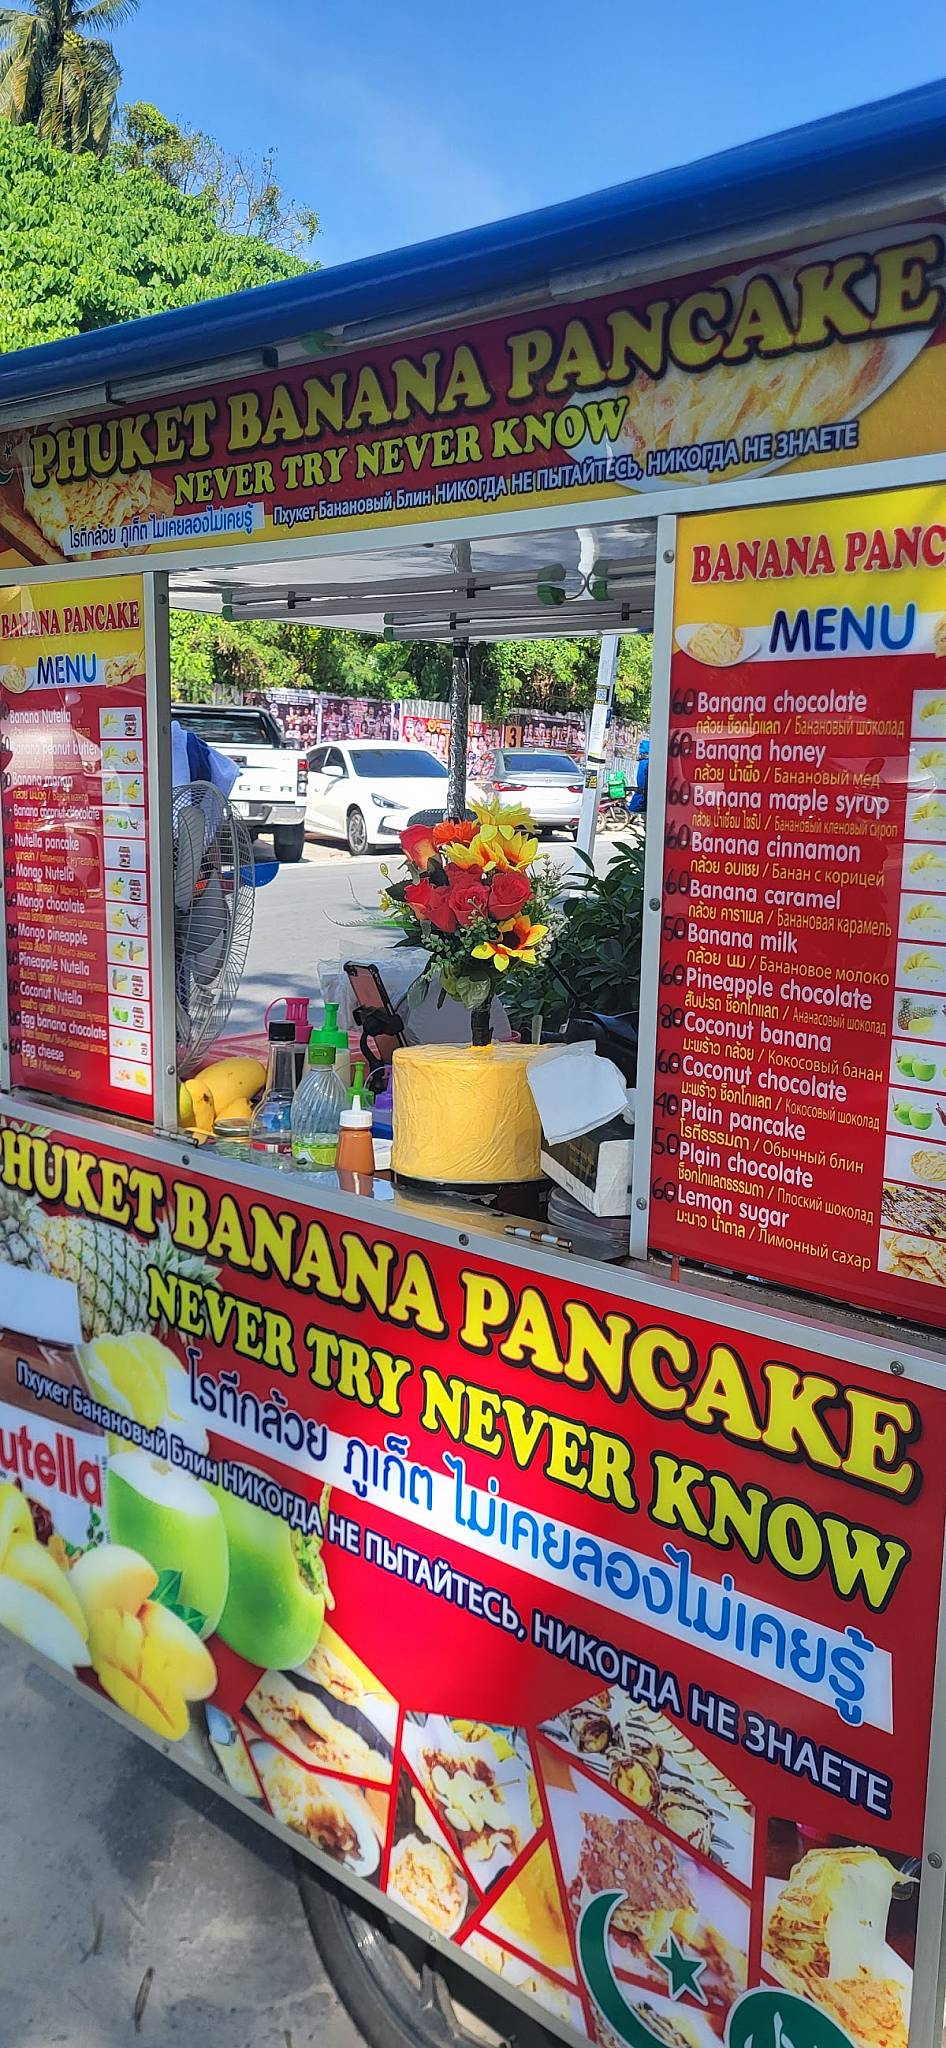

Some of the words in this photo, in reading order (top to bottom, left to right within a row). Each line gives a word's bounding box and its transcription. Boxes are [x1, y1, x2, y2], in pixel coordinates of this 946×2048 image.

[29, 398, 217, 485] PHUKET
[228, 345, 492, 450] BANANA
[506, 240, 941, 400] PANCAKE
[174, 460, 275, 505] NEVER
[281, 447, 350, 488] TRY
[355, 427, 482, 478] NEVER
[492, 398, 630, 458] KNOW
[274, 506, 315, 527] Пхукет
[319, 494, 394, 519] Банановый
[396, 488, 431, 507] Блин
[435, 476, 508, 502] НИКОГДА
[511, 472, 533, 493] НЕ
[536, 460, 643, 491] ПЫТАЙТЕСЬ,
[647, 443, 739, 475] НИКОГДА
[744, 436, 773, 462] НЕ
[776, 422, 859, 457] ЗНАЕТЕ
[70, 524, 116, 549] โรตีกล้วย
[120, 516, 148, 549] ภูเก็ต
[151, 503, 254, 539] ไม่เคยลองไม่เคยรู้
[691, 534, 835, 584] BANANA
[844, 524, 946, 572] PANC
[1, 609, 61, 638] BANANA
[63, 601, 140, 633] PANCAKE
[768, 602, 916, 654] MENU
[37, 653, 97, 684] MENU
[697, 691, 766, 713] Banana
[773, 688, 867, 713] chocolate
[9, 710, 39, 724] Banana
[696, 715, 723, 734] กล้วย
[795, 715, 854, 736] Банановый
[856, 720, 904, 740] шоколад
[695, 739, 762, 760] Banana
[769, 738, 826, 768] honey
[694, 763, 724, 781] กล้วย
[774, 768, 849, 785] Банановый
[693, 785, 761, 809] Banana
[769, 788, 829, 817] maple
[835, 795, 890, 820] syrup
[14, 833, 42, 848] Nutella
[45, 836, 80, 852] pancake
[691, 832, 759, 856] Banana
[766, 834, 860, 863] cinnamon
[45, 865, 74, 882] Nutella
[690, 854, 720, 875] กล้วย
[724, 862, 760, 877] อบเชย
[772, 863, 811, 881] Банан
[814, 871, 821, 882] с
[825, 870, 885, 888] корицей
[46, 896, 86, 914] chocolate
[690, 879, 757, 903] Banana
[764, 889, 841, 910] caramel
[688, 900, 716, 919] กล้วย
[721, 908, 764, 924] คาราเมล
[777, 908, 834, 931] Банановая
[837, 920, 892, 938] карамель
[47, 926, 88, 947] pineapple
[688, 922, 753, 948] Banana
[760, 931, 798, 954] milk
[18, 952, 59, 971] Pineapple
[60, 958, 90, 976] Nutella
[687, 946, 721, 965] กล้วย
[727, 954, 746, 968] นม
[760, 956, 832, 979] Банановое
[835, 968, 890, 986] молоко
[20, 981, 51, 999] Coconut
[53, 987, 83, 1005] Nutella
[686, 966, 774, 998] Pineapple
[780, 978, 872, 1010] chocolate
[21, 1011, 35, 1029] Egg
[37, 1013, 67, 1032] banana
[68, 1021, 107, 1040] chocolate
[684, 1011, 754, 1040] Coconut
[760, 1020, 832, 1053] banana
[793, 1007, 845, 1029] Ананасовый
[847, 1020, 887, 1037] шоколад
[21, 1040, 36, 1058] Egg
[37, 1043, 65, 1061] cheese
[683, 1036, 721, 1056] มะพร้าว
[725, 1040, 754, 1061] กล้วย
[682, 1055, 752, 1085] Coconut
[758, 1067, 847, 1102] chocolate
[768, 1049, 839, 1075] Кокосовый
[843, 1061, 883, 1082] банан
[681, 1080, 717, 1099] มะพร้าว
[720, 1082, 772, 1110] ช็อกโกแลต
[681, 1098, 723, 1125] Plain
[729, 1111, 806, 1141] pancake
[785, 1098, 836, 1121] Кокосовый
[837, 1111, 880, 1132] шоколад
[680, 1117, 750, 1151] โรตีธรรมดา
[680, 1141, 721, 1168] Plain
[727, 1151, 813, 1188] chocolate
[763, 1139, 826, 1166] Обычный
[829, 1153, 864, 1174] блин
[676, 1209, 708, 1228] มะนาว
[678, 1184, 732, 1215] Lemon
[739, 1202, 790, 1228] sugar
[777, 1187, 823, 1212] Плоский
[825, 1202, 874, 1226] шоколад
[758, 1228, 829, 1259] Лимонный
[832, 1249, 872, 1273] сахар
[0, 1129, 163, 1234] HUKET
[173, 1183, 446, 1332] BANANA
[458, 1270, 915, 1496] PANCAKE
[147, 1268, 298, 1374] NEVER
[306, 1328, 412, 1416] TRY
[422, 1370, 638, 1511] NEVER
[652, 1455, 907, 1609] KNOW
[187, 1347, 328, 1462] โรตีกล้วย
[344, 1434, 434, 1511] ภูเก็ต
[442, 1452, 876, 1726] ไม่เคยลองไม่เคยรู้
[17, 1361, 69, 1406] Пхукет
[73, 1389, 167, 1456] Банановый
[170, 1433, 218, 1484] Блин
[222, 1462, 323, 1538] НИКОГДА
[329, 1515, 361, 1555] НЕ
[365, 1536, 527, 1639] ПЫТАЙТЕСЬ,
[533, 1611, 681, 1716] НИКОГДА
[690, 1690, 737, 1741] НЕ
[745, 1720, 891, 1816] ЗНАЕТЕ
